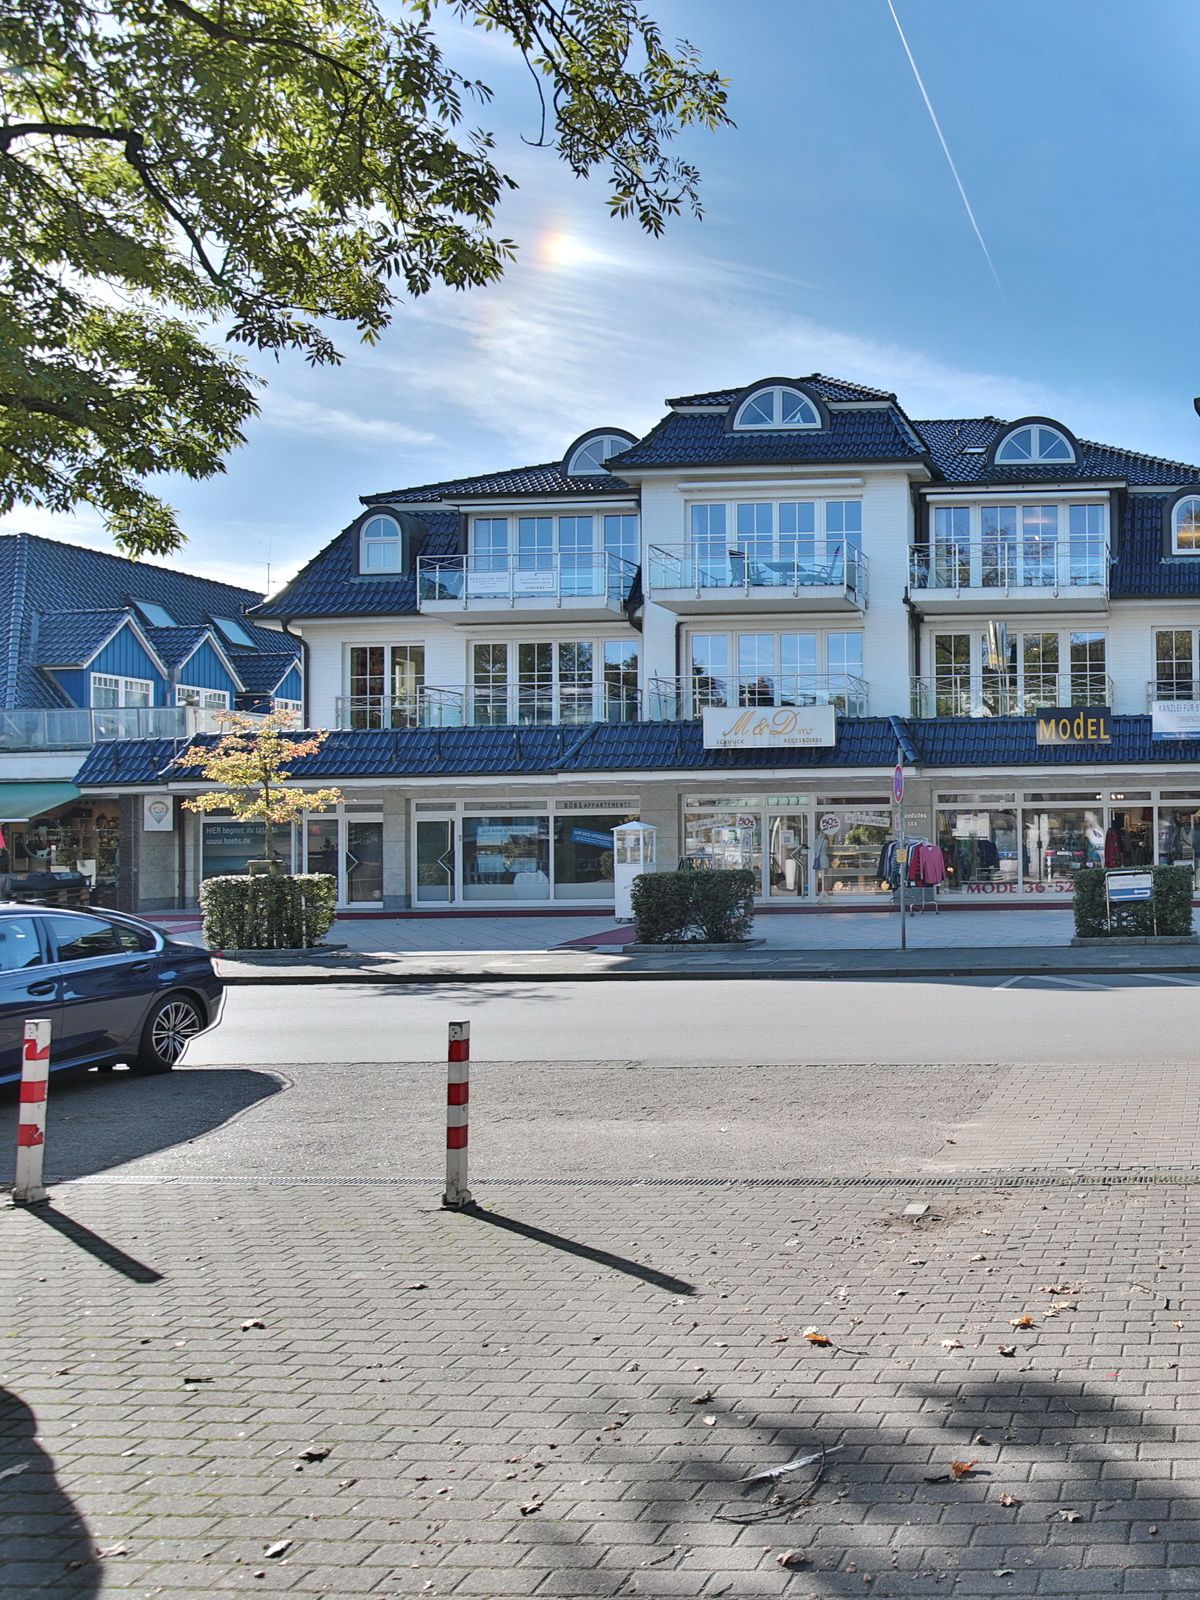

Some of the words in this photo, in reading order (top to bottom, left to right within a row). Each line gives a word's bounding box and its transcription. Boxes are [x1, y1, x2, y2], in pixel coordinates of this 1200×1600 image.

[1158, 703, 1182, 713] KANZLEI
[1183, 701, 1195, 713] FÜR
[722, 710, 757, 737] M
[752, 718, 770, 737] &
[768, 709, 801, 736] D
[206, 826, 222, 834] HIER
[222, 826, 246, 835] beginnt
[205, 837, 251, 845] www.boebs.de
[966, 882, 1018, 894] MODE
